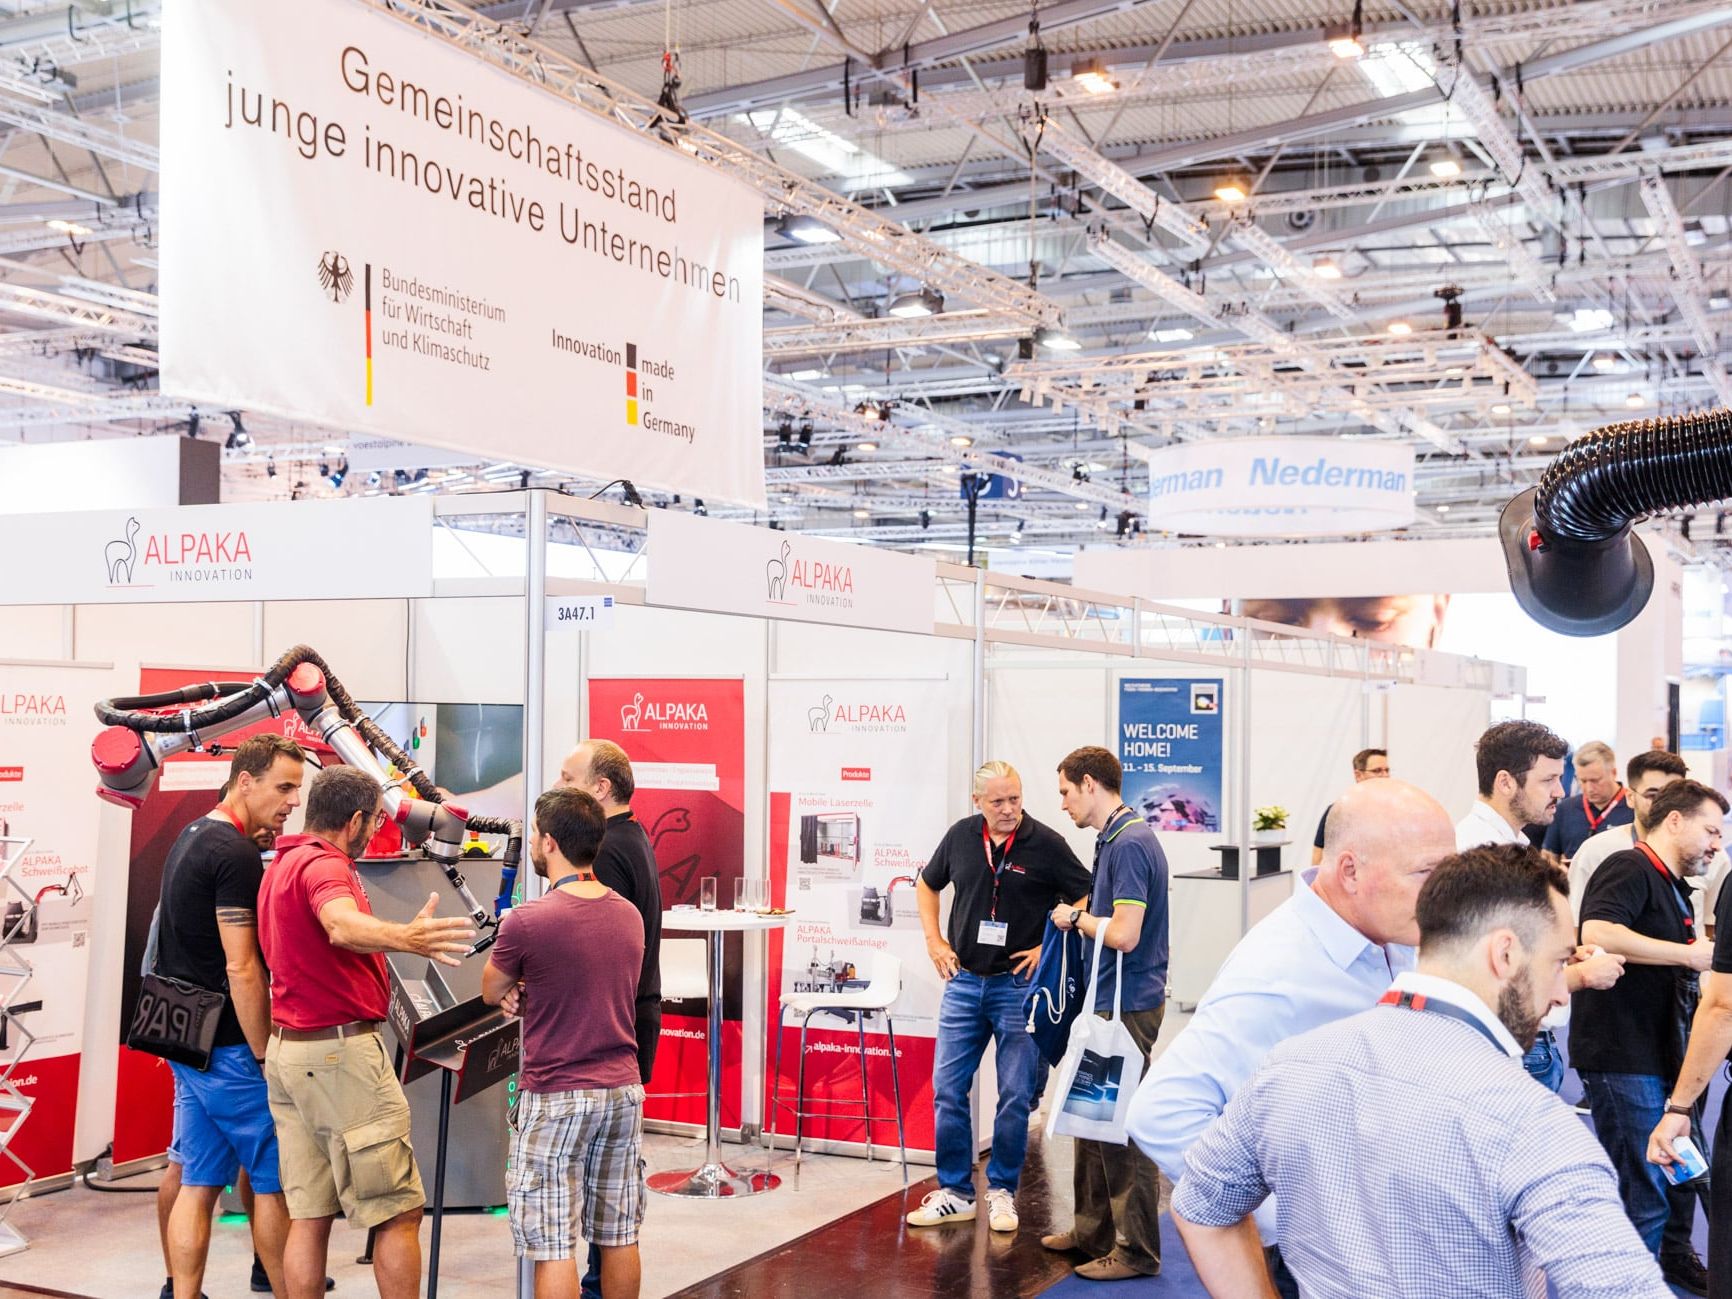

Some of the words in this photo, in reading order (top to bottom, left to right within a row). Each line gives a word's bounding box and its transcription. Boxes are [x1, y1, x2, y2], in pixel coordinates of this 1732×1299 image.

[341, 46, 676, 223] Gemeinschaftsstand
[225, 70, 346, 159] junge
[365, 124, 544, 231] innovative
[560, 202, 740, 303] Unternehmen
[382, 268, 506, 323] Bundesministerium
[382, 296, 401, 318] für
[405, 303, 472, 340] Wirtschaft
[382, 330, 408, 349] und
[413, 333, 490, 371] Klimaschutz
[552, 329, 621, 366] Innovation
[642, 359, 674, 380] made
[642, 382, 653, 402] in
[643, 411, 695, 444] Germany
[1249, 457, 1406, 493] Nederman
[144, 532, 252, 565] ALPAKA
[170, 568, 252, 582] INNOVATION
[791, 559, 853, 593] ALPAKA
[806, 593, 853, 609] INNOVATION
[558, 606, 595, 621] 3A47.1
[644, 703, 708, 721] ALPAKA
[834, 705, 906, 722] ALPAKA
[659, 722, 708, 730] INNOVATION
[851, 725, 906, 733] INNOVATION
[1123, 723, 1199, 739] WELCOME
[1124, 741, 1171, 757] HOME!
[842, 770, 869, 779] Produkte
[1157, 763, 1203, 774] September
[799, 798, 828, 806] Mobile
[23, 855, 61, 866] ALPAKA
[874, 848, 909, 857] ALPAKA
[797, 925, 831, 934] ALPAKA
